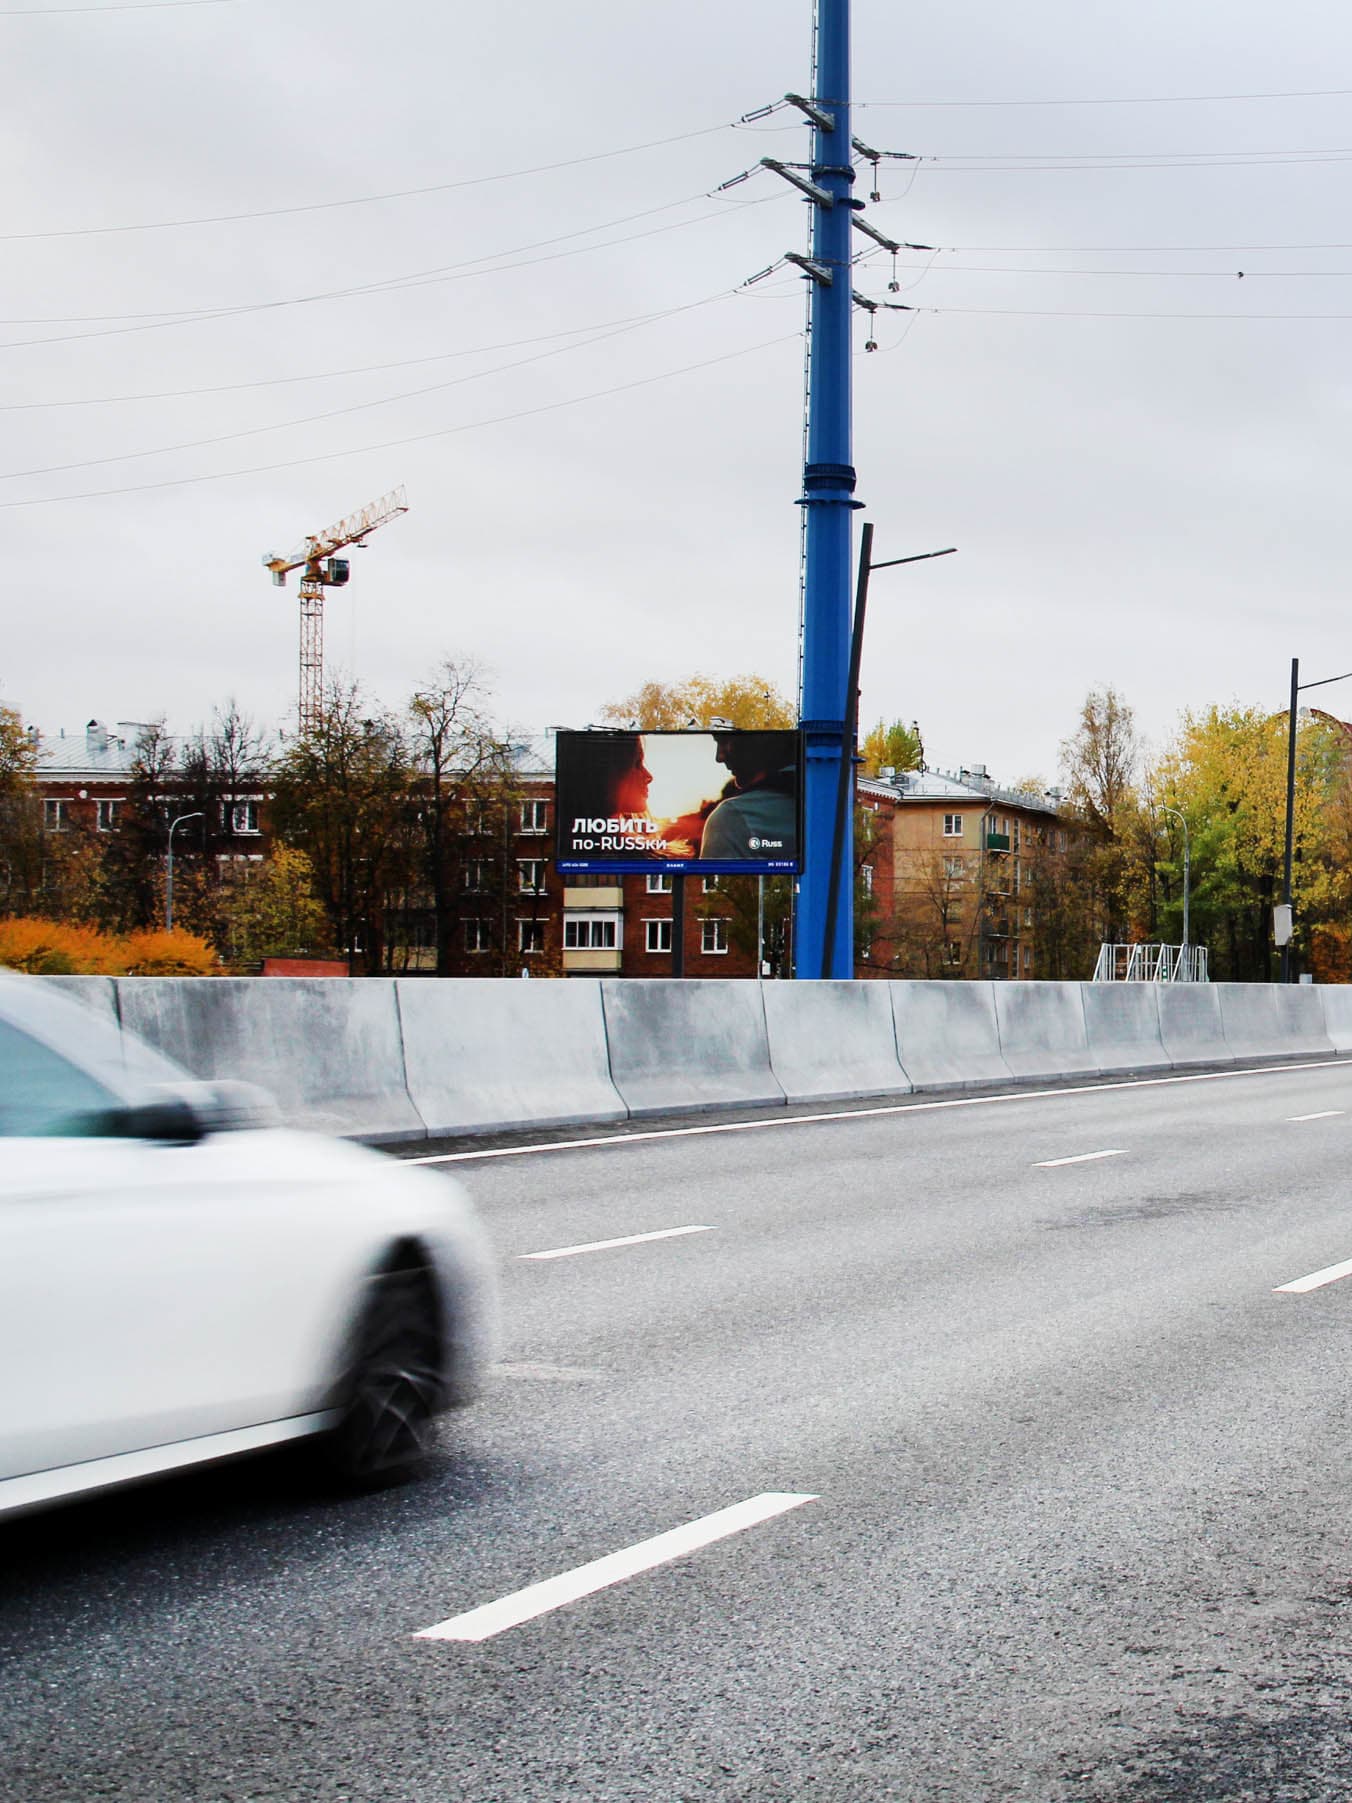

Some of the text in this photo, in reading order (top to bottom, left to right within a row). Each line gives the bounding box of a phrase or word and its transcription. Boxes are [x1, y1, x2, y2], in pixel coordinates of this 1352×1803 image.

[572, 818, 658, 833] ЛЮБИТЬ
[572, 836, 668, 850] по-RUSSки
[761, 839, 783, 848] Russ
